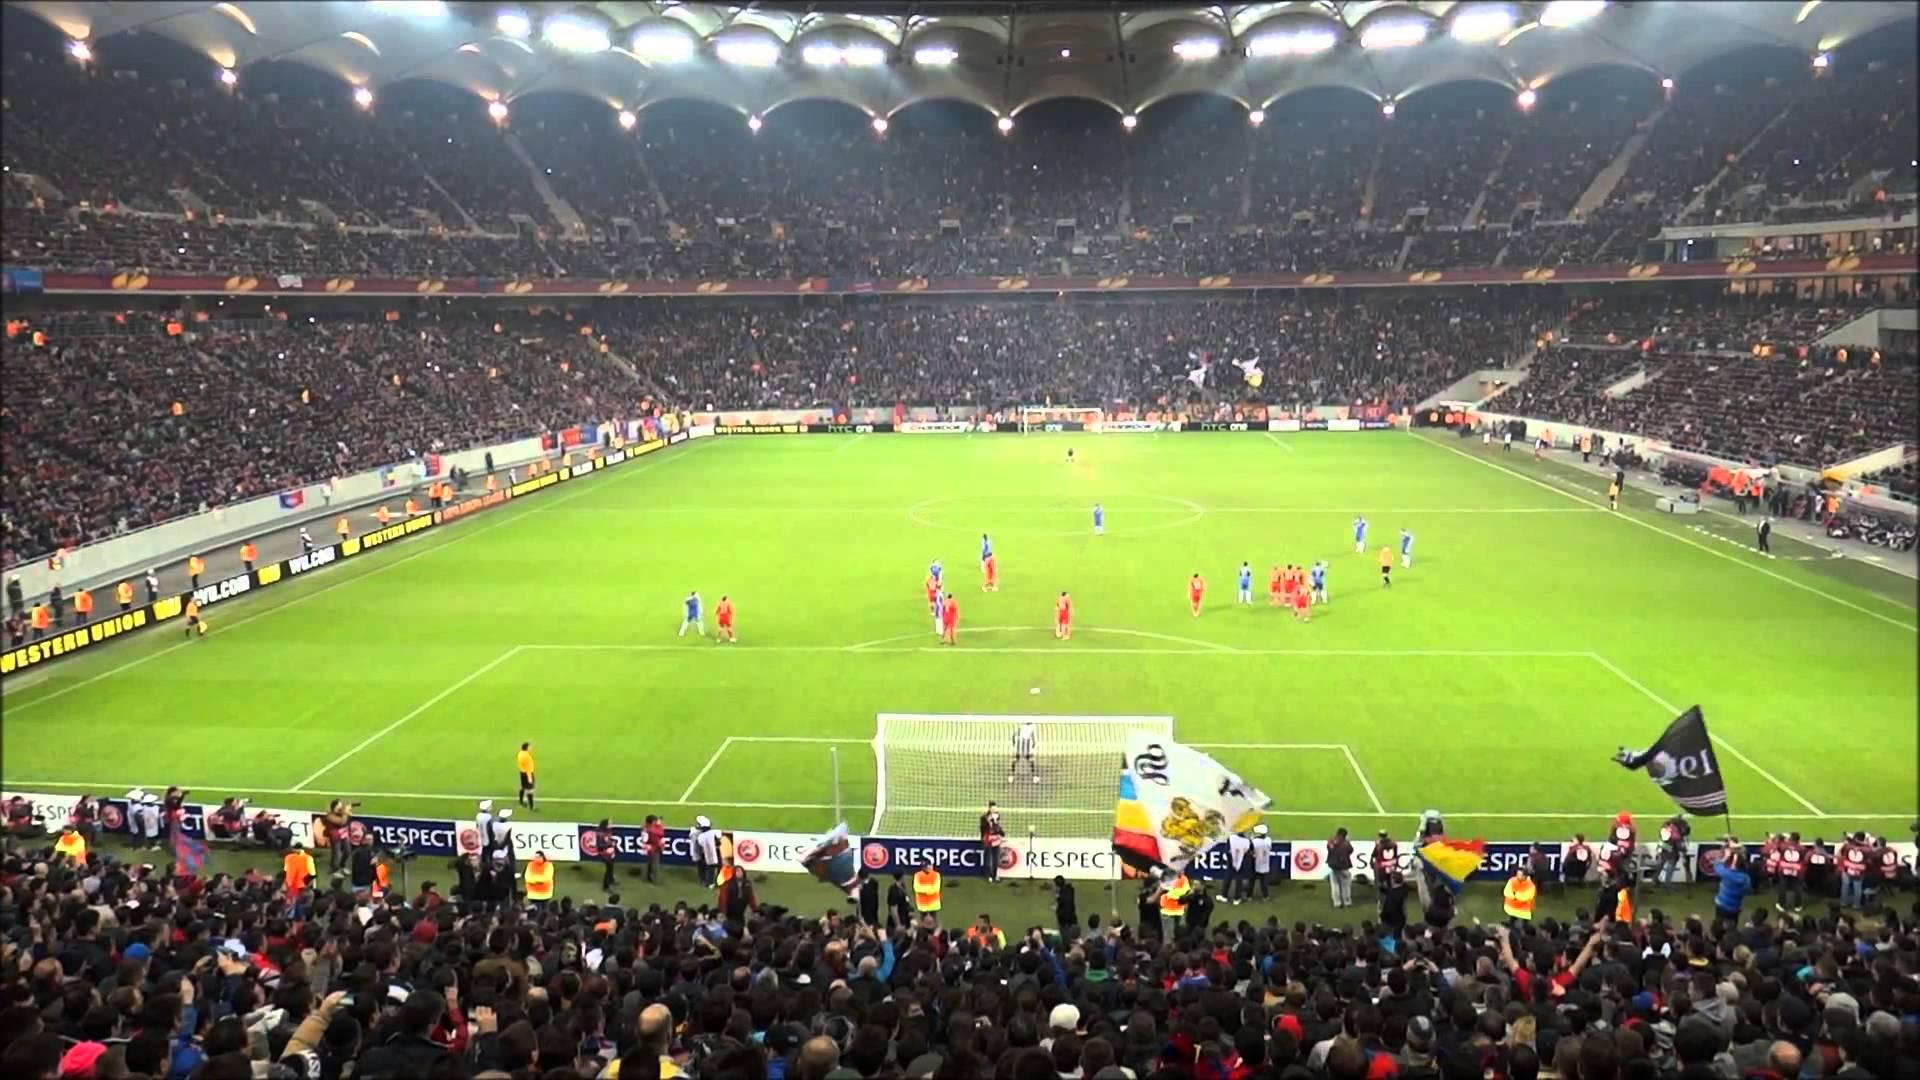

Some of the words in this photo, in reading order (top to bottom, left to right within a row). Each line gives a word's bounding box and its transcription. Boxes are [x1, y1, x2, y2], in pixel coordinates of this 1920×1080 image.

[362, 523, 406, 549] WESTERN
[0, 629, 90, 673] WESTERN
[90, 609, 146, 642] UNION
[373, 826, 456, 849] RESPECT
[514, 832, 578, 851] SPECT
[894, 846, 985, 868] RESPECT
[1026, 850, 1116, 870] RESPECT
